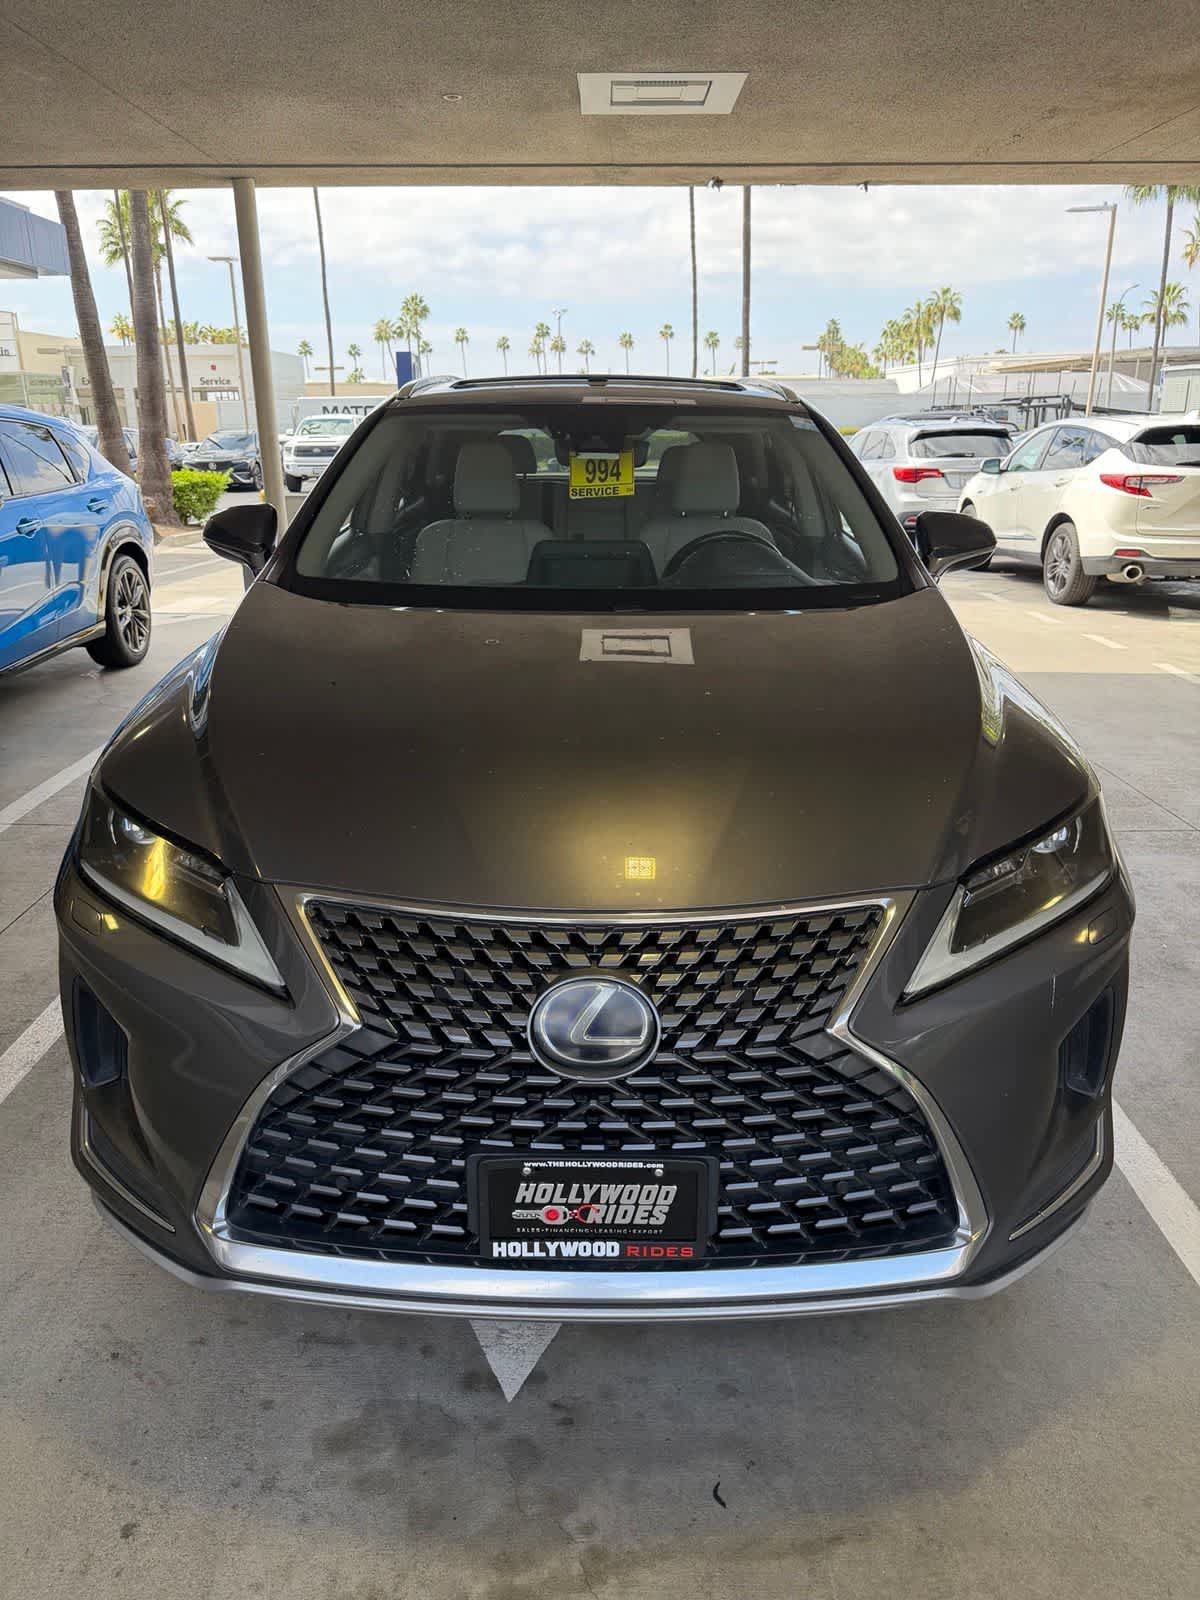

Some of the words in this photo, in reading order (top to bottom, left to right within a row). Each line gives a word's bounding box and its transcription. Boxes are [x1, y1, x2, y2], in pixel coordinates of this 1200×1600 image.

[200, 377, 230, 385] Service
[585, 459, 621, 483] 994
[515, 1183, 678, 1205] HOLLYWOOD
[588, 1204, 669, 1226] RIDES
[492, 1241, 620, 1257] HOLLYWOOD
[627, 1245, 693, 1257] RIDES
